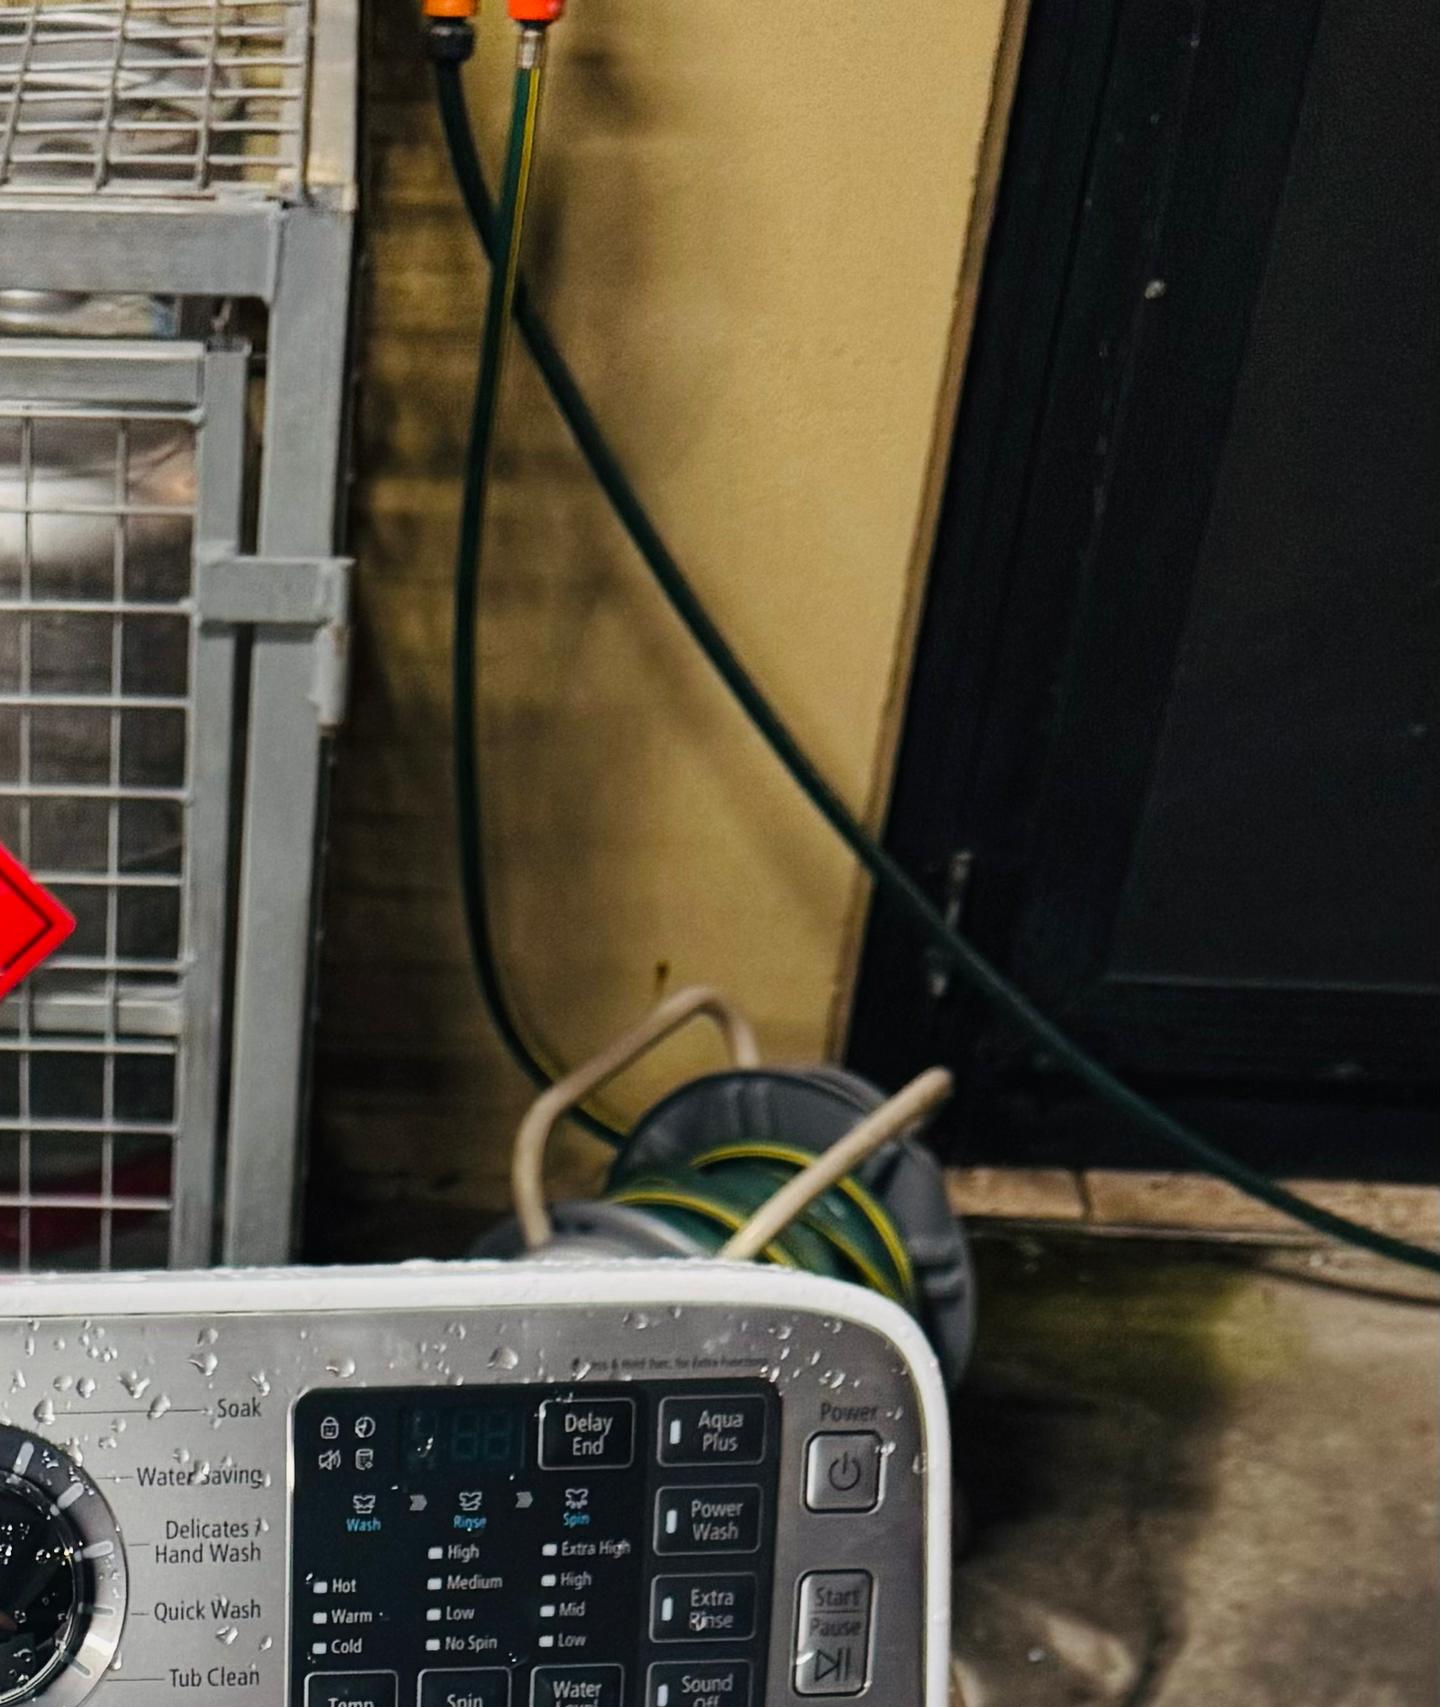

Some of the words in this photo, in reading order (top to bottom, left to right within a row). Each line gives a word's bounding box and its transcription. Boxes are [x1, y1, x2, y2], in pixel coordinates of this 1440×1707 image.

[217, 1398, 262, 1419] Soak
[819, 1401, 878, 1423] Power
[563, 1413, 613, 1436] Delay
[697, 1409, 744, 1430] Aqua
[571, 1436, 604, 1457] End
[702, 1432, 738, 1452] Plus
[136, 1466, 195, 1488] Water
[691, 1499, 743, 1519] Power
[165, 1517, 249, 1540] Delicates
[346, 1518, 382, 1533] Wash
[453, 1515, 487, 1530] Rinse
[562, 1512, 591, 1528] Spin
[692, 1521, 739, 1542] Wash
[155, 1542, 204, 1564] Hand
[209, 1541, 261, 1563] Wash
[447, 1545, 480, 1563] High
[561, 1541, 596, 1557] Extra
[599, 1538, 631, 1559] High
[331, 1578, 357, 1593] Hot
[446, 1574, 503, 1591] Medium
[560, 1572, 592, 1591] High
[690, 1588, 735, 1607] Extra
[814, 1586, 861, 1607] Start
[154, 1600, 206, 1621] Quick
[210, 1599, 261, 1620] Wash
[331, 1609, 373, 1624] Warm
[445, 1606, 475, 1621] Low
[559, 1602, 586, 1617] Mid
[688, 1610, 734, 1631] Rinse
[810, 1617, 862, 1637] Pause
[331, 1639, 363, 1654] Cold
[444, 1636, 465, 1651] No
[467, 1635, 498, 1653] Spin
[557, 1633, 587, 1648] Low
[169, 1667, 202, 1688] Tub
[207, 1667, 260, 1688] Clean
[681, 1674, 734, 1694] Sound
[552, 1680, 602, 1699] Water
